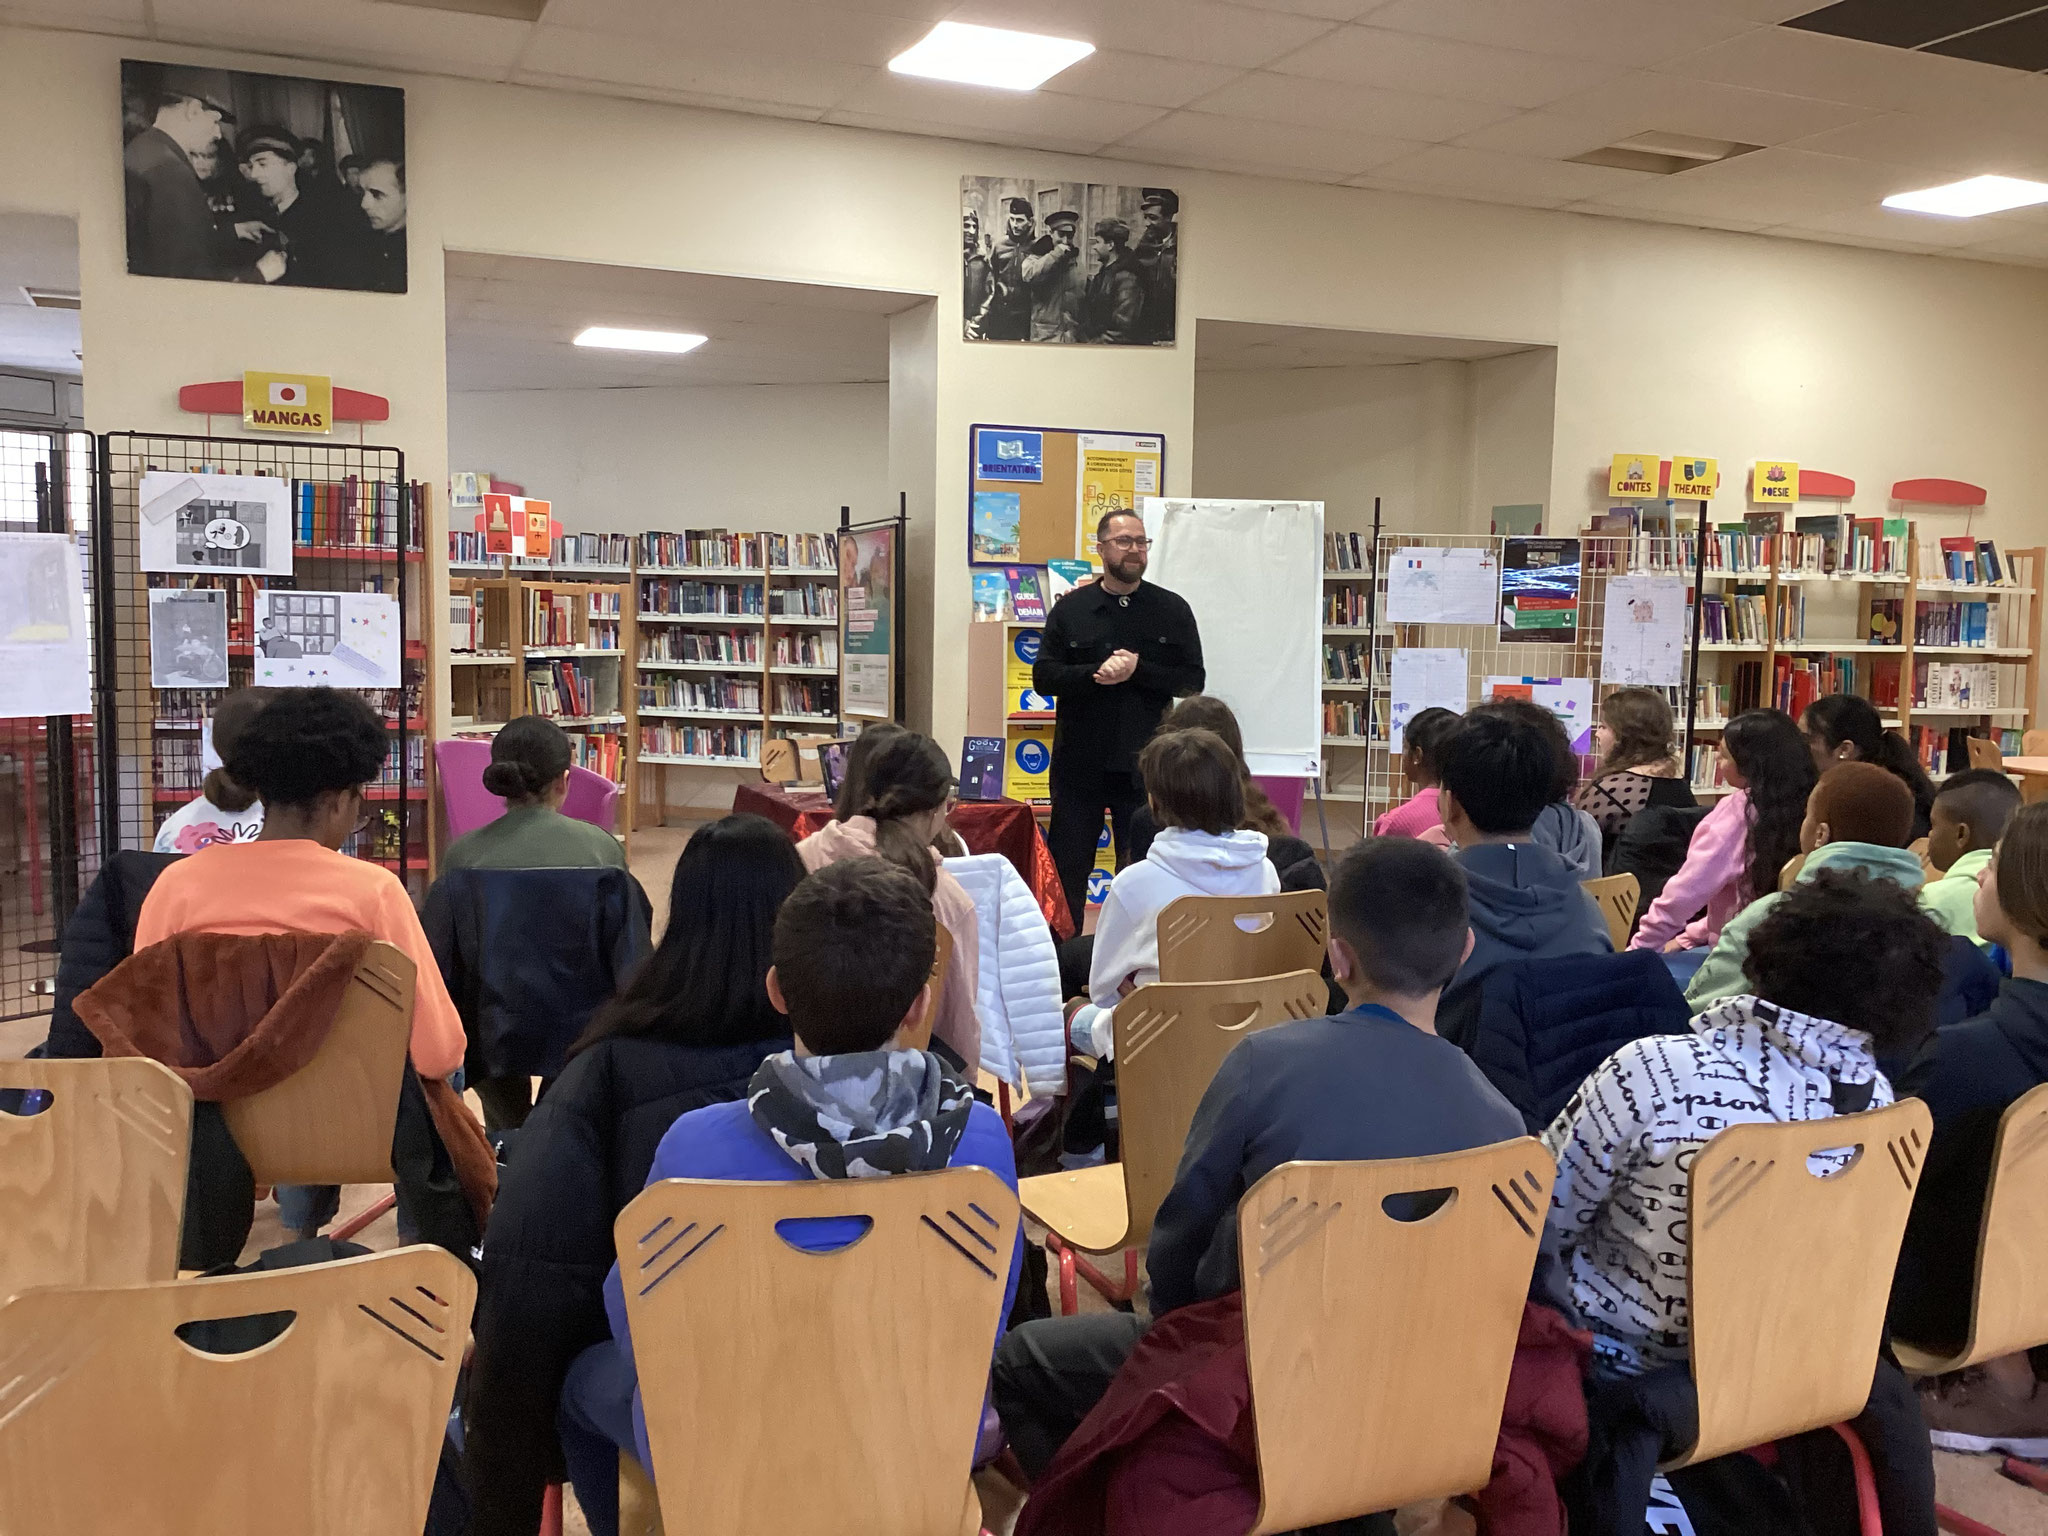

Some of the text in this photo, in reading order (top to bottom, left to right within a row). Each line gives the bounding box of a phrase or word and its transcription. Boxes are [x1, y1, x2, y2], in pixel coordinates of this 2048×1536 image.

[253, 410, 322, 427] MANGAS
[982, 464, 1037, 474] ORIENTATION
[1617, 482, 1651, 492] CONTES
[1674, 483, 1711, 496] THEATRE
[1762, 487, 1789, 497] POESIE
